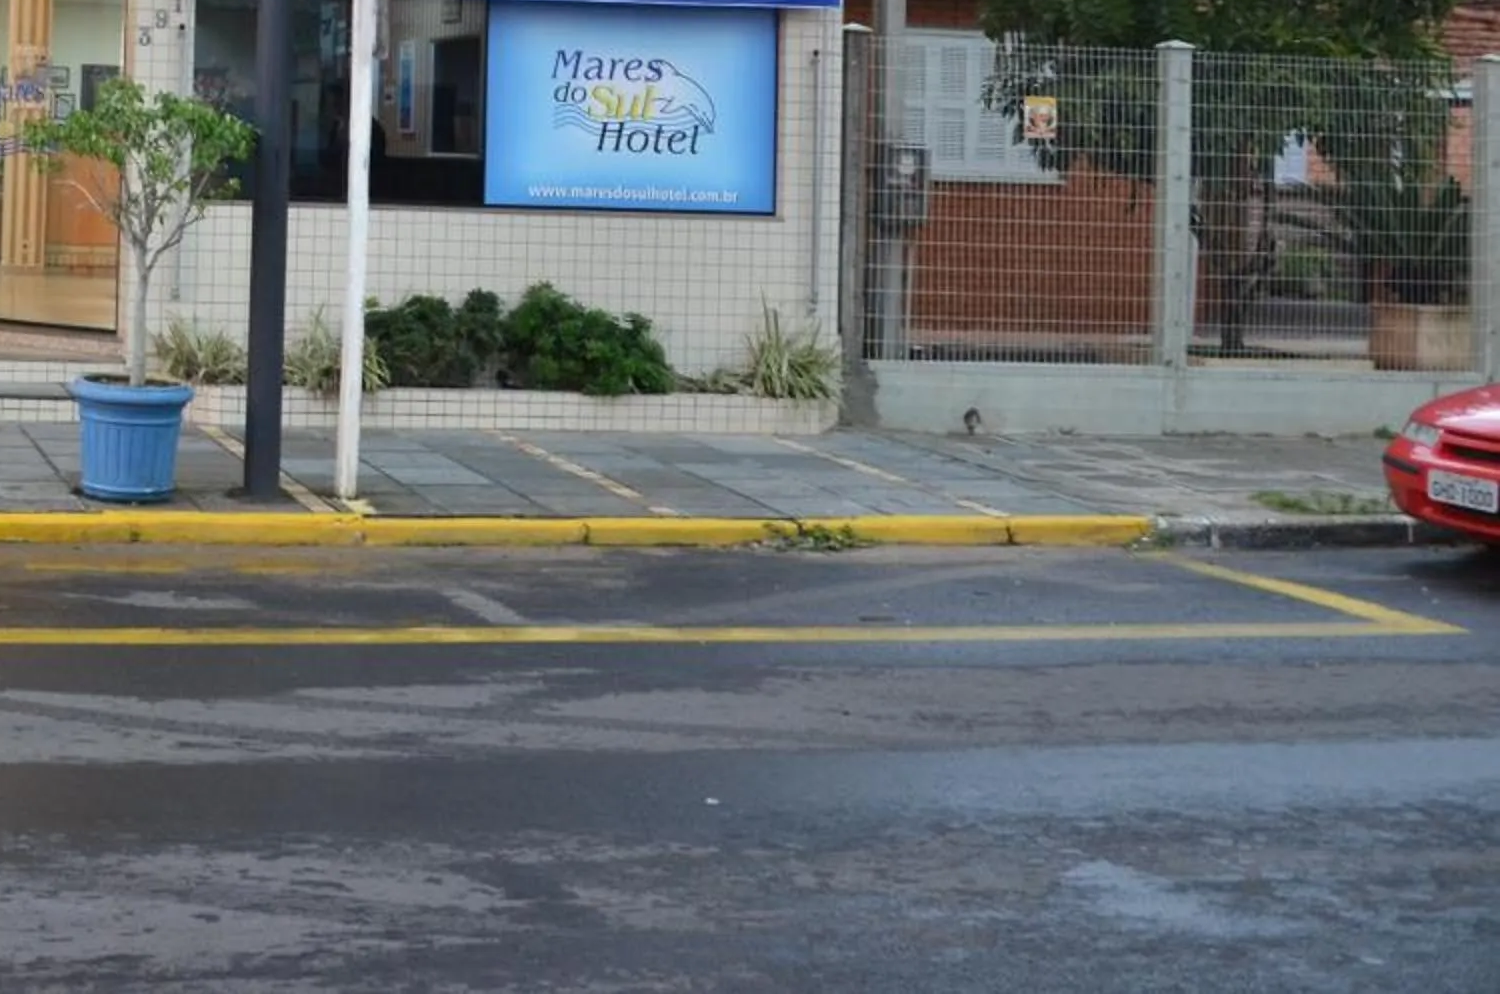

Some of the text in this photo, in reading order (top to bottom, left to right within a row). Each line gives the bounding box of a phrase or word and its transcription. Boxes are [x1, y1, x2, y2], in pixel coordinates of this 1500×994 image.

[551, 49, 663, 82] Mares
[553, 81, 657, 122] do Sul
[597, 121, 700, 155] Hotel
[528, 183, 738, 203] www.maresdosulhotel.com.br
